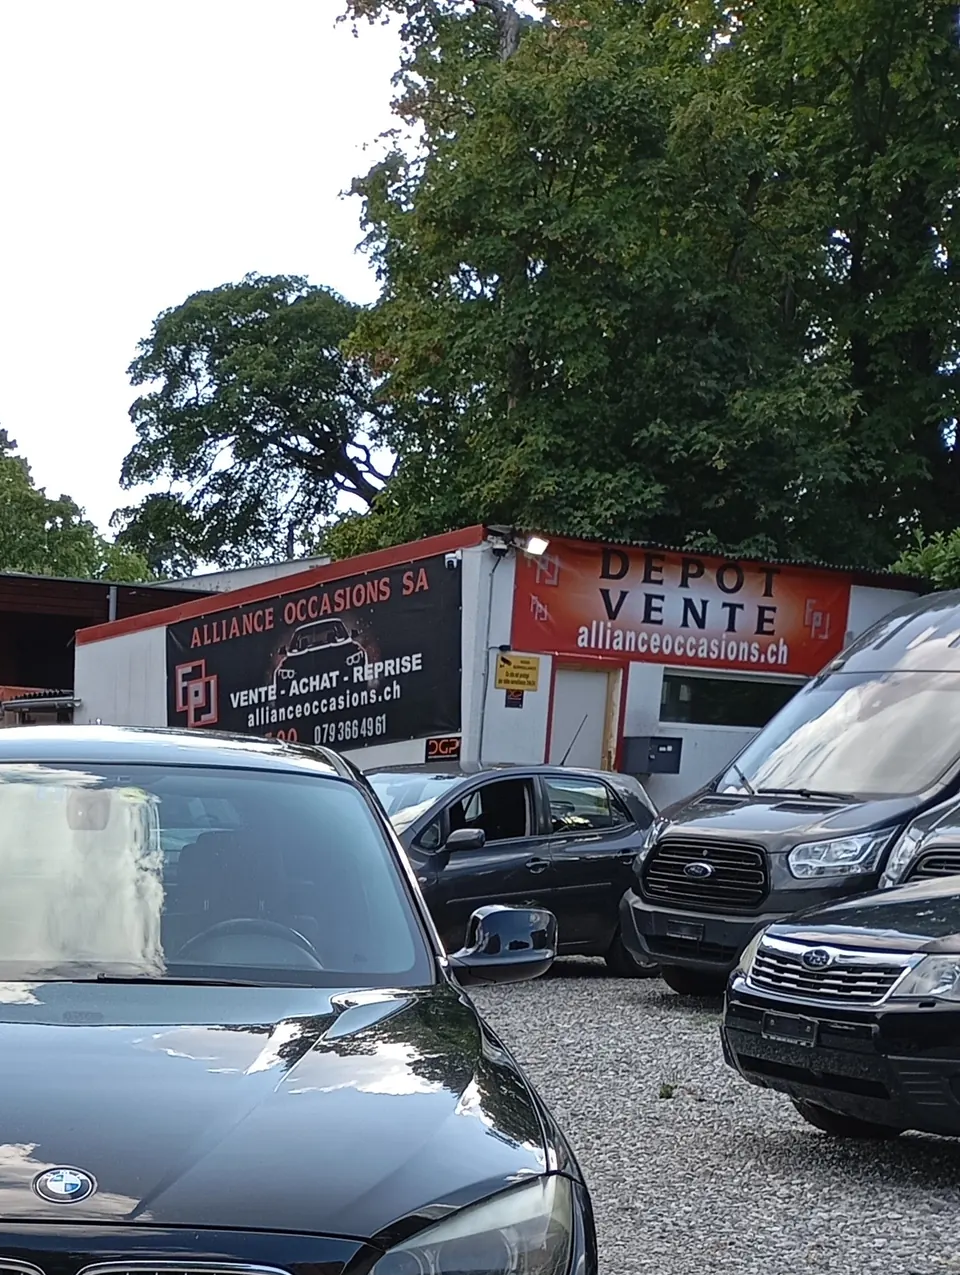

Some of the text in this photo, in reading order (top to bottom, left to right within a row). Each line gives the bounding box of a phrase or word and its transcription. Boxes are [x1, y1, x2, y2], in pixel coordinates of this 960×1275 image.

[598, 548, 781, 598] DEPOT
[190, 567, 429, 649] ALLIANCE OCCASIONS SA
[598, 587, 778, 636] VENTE
[577, 620, 789, 665] allianceoccasions.ch
[229, 684, 277, 709] VENTE
[288, 670, 340, 698] ACHAT
[352, 653, 423, 684] REPRISE
[247, 680, 401, 728] allianceoccasions.ch
